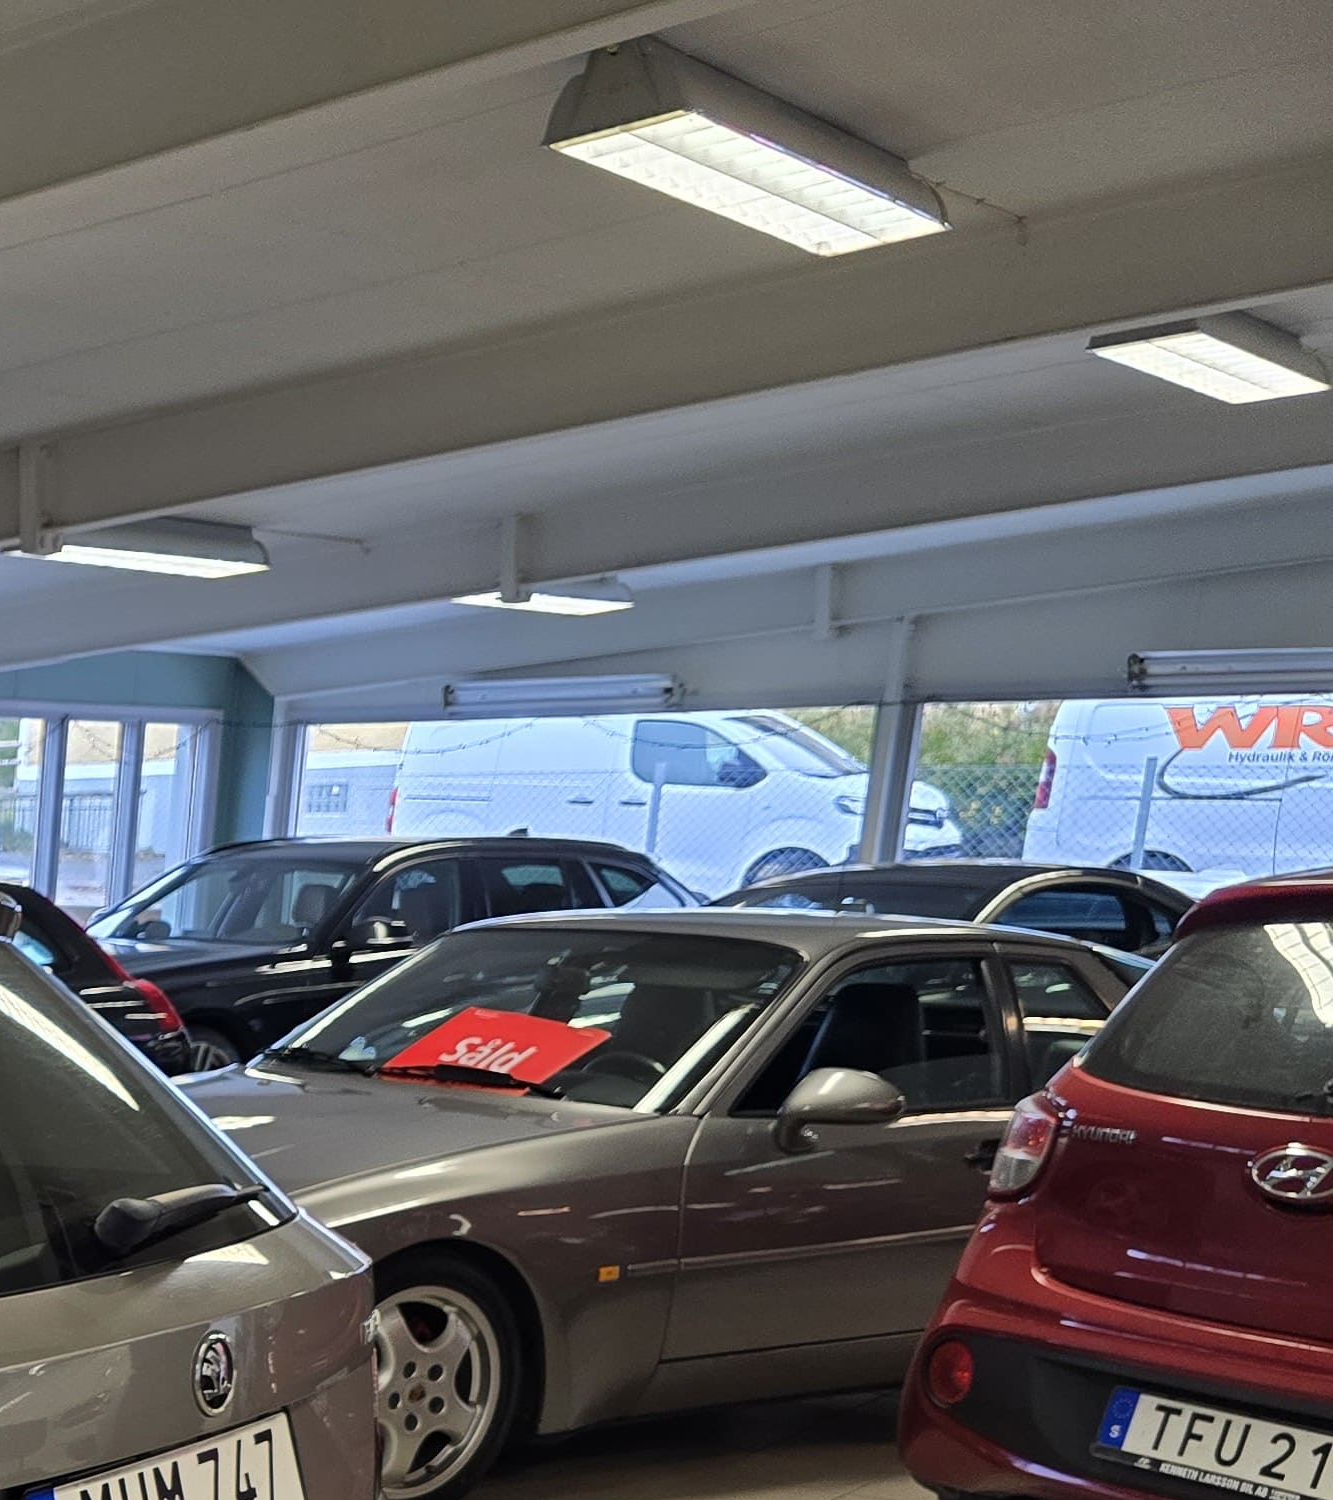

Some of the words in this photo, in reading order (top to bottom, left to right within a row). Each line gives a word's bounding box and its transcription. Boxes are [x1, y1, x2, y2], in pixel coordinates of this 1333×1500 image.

[1228, 751, 1294, 765] Hydraulik
[1299, 751, 1308, 762] &
[438, 1036, 538, 1074] Såld
[1109, 1425, 1121, 1438] S
[1152, 1404, 1251, 1467] TFU
[1159, 1463, 1198, 1481] KENNETH
[1199, 1471, 1239, 1492] LARSSON
